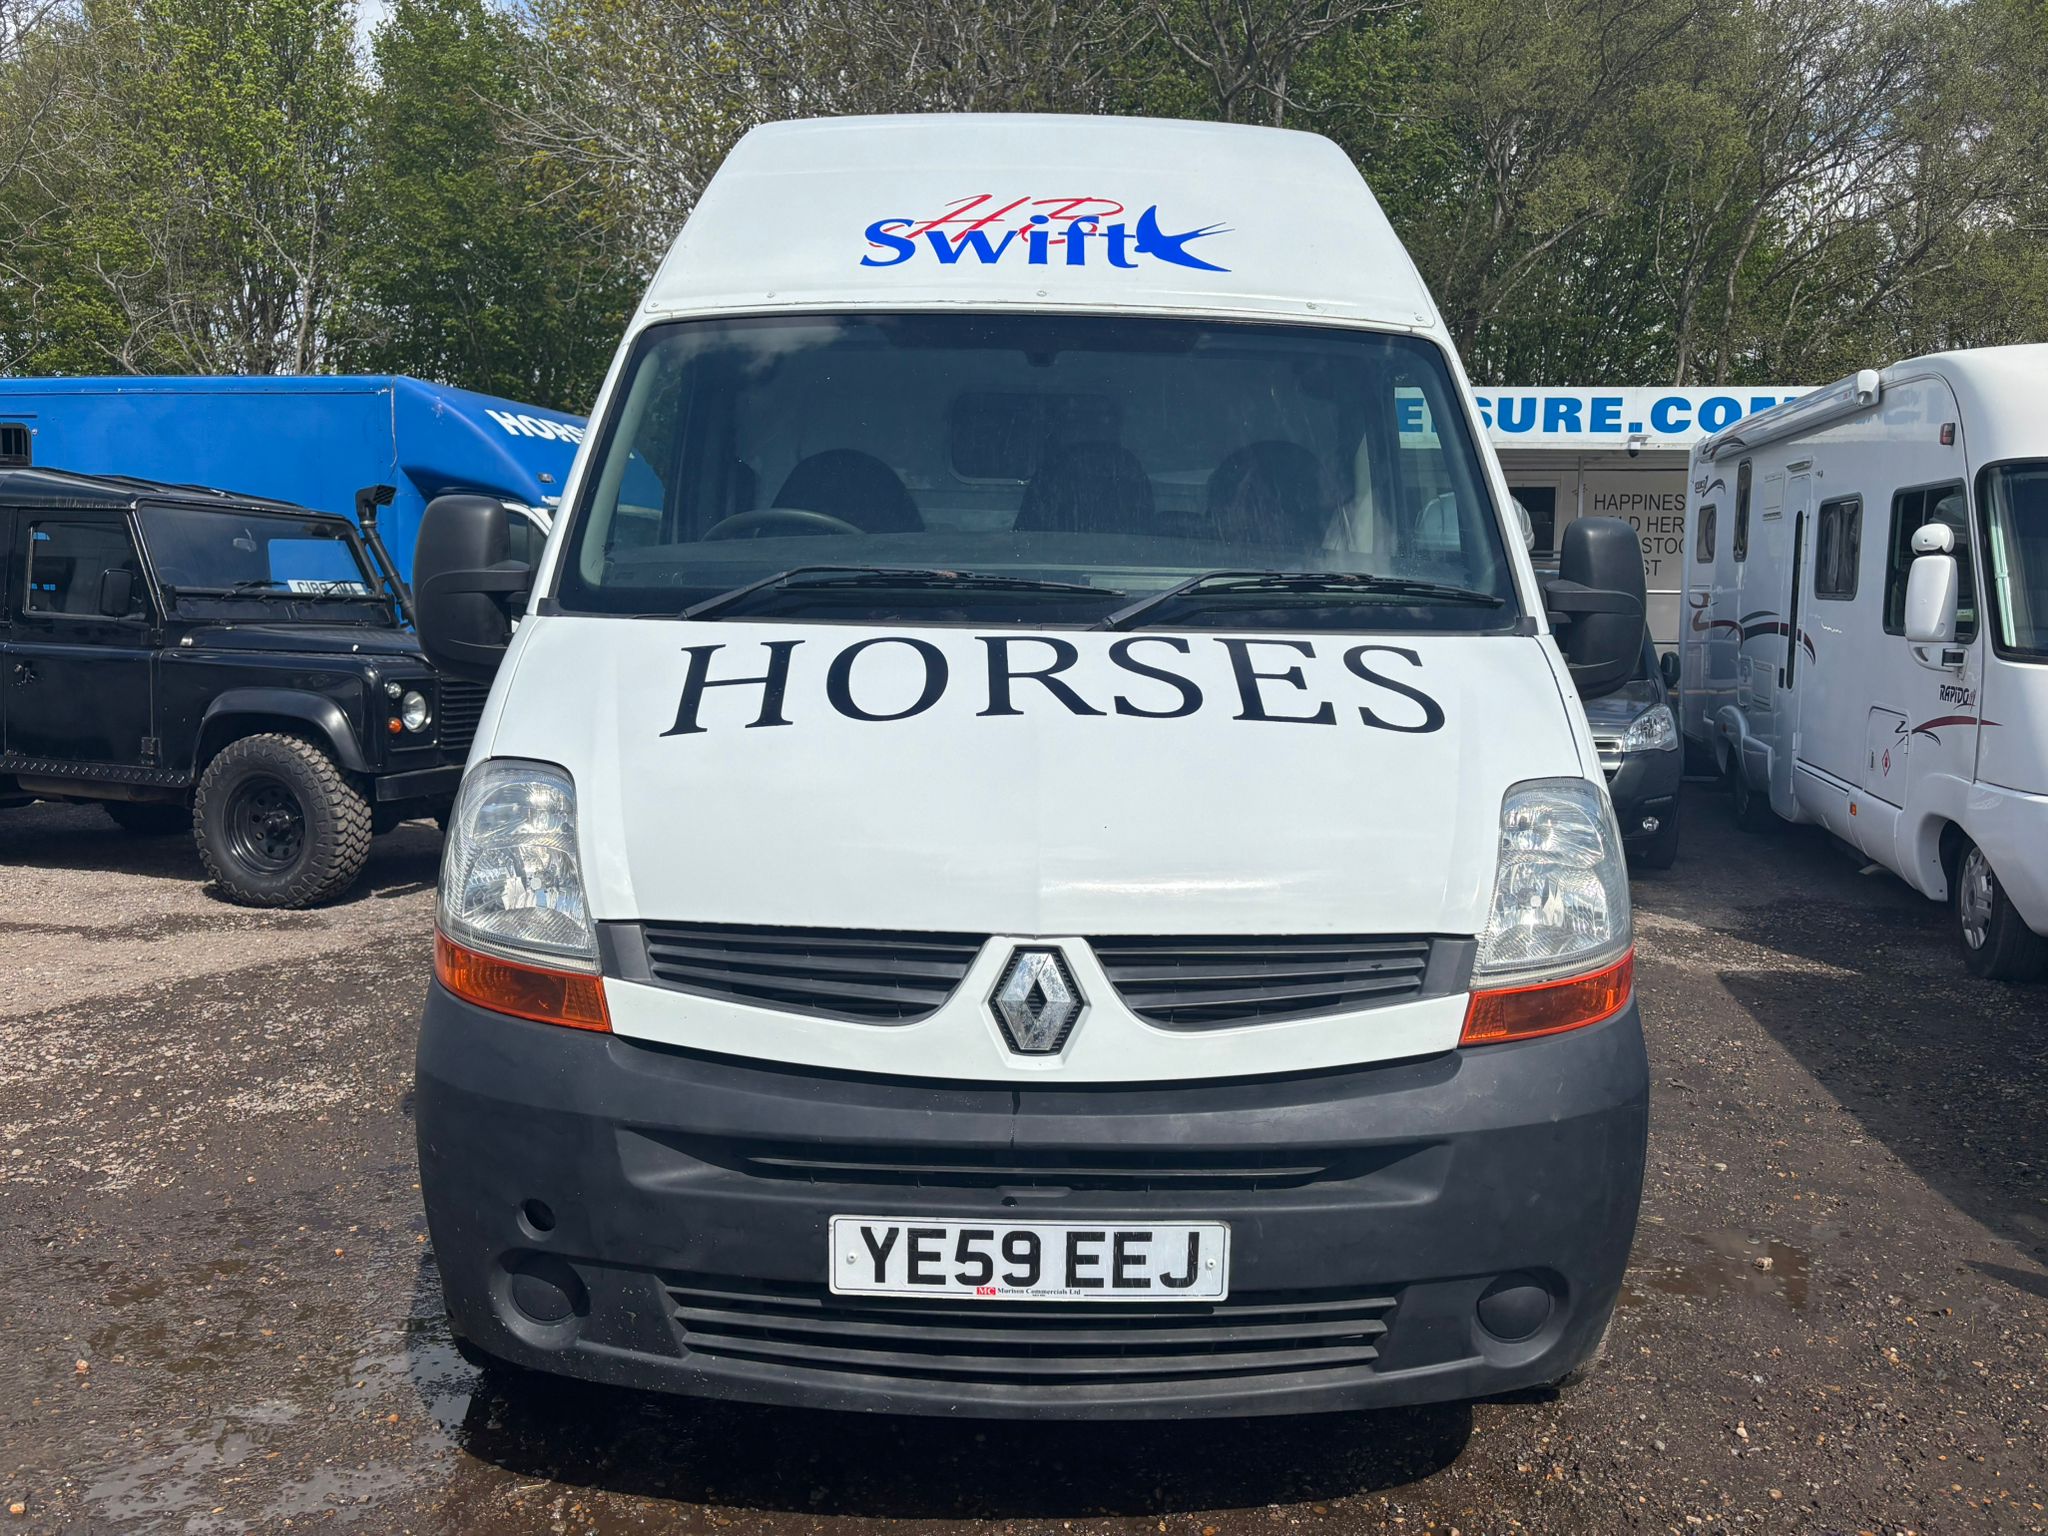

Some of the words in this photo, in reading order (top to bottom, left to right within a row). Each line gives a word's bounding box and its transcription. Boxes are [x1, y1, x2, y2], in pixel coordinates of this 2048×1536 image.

[860, 213, 1138, 269] Swift
[485, 409, 587, 445] HORS
[1394, 396, 1797, 434] EURE.CO
[1594, 494, 1685, 510] HAPPINES
[659, 637, 1445, 738] HORSES
[1940, 685, 1969, 704] RAPIDO
[860, 1226, 1041, 1287] YE59
[1066, 1230, 1200, 1289] EEJ
